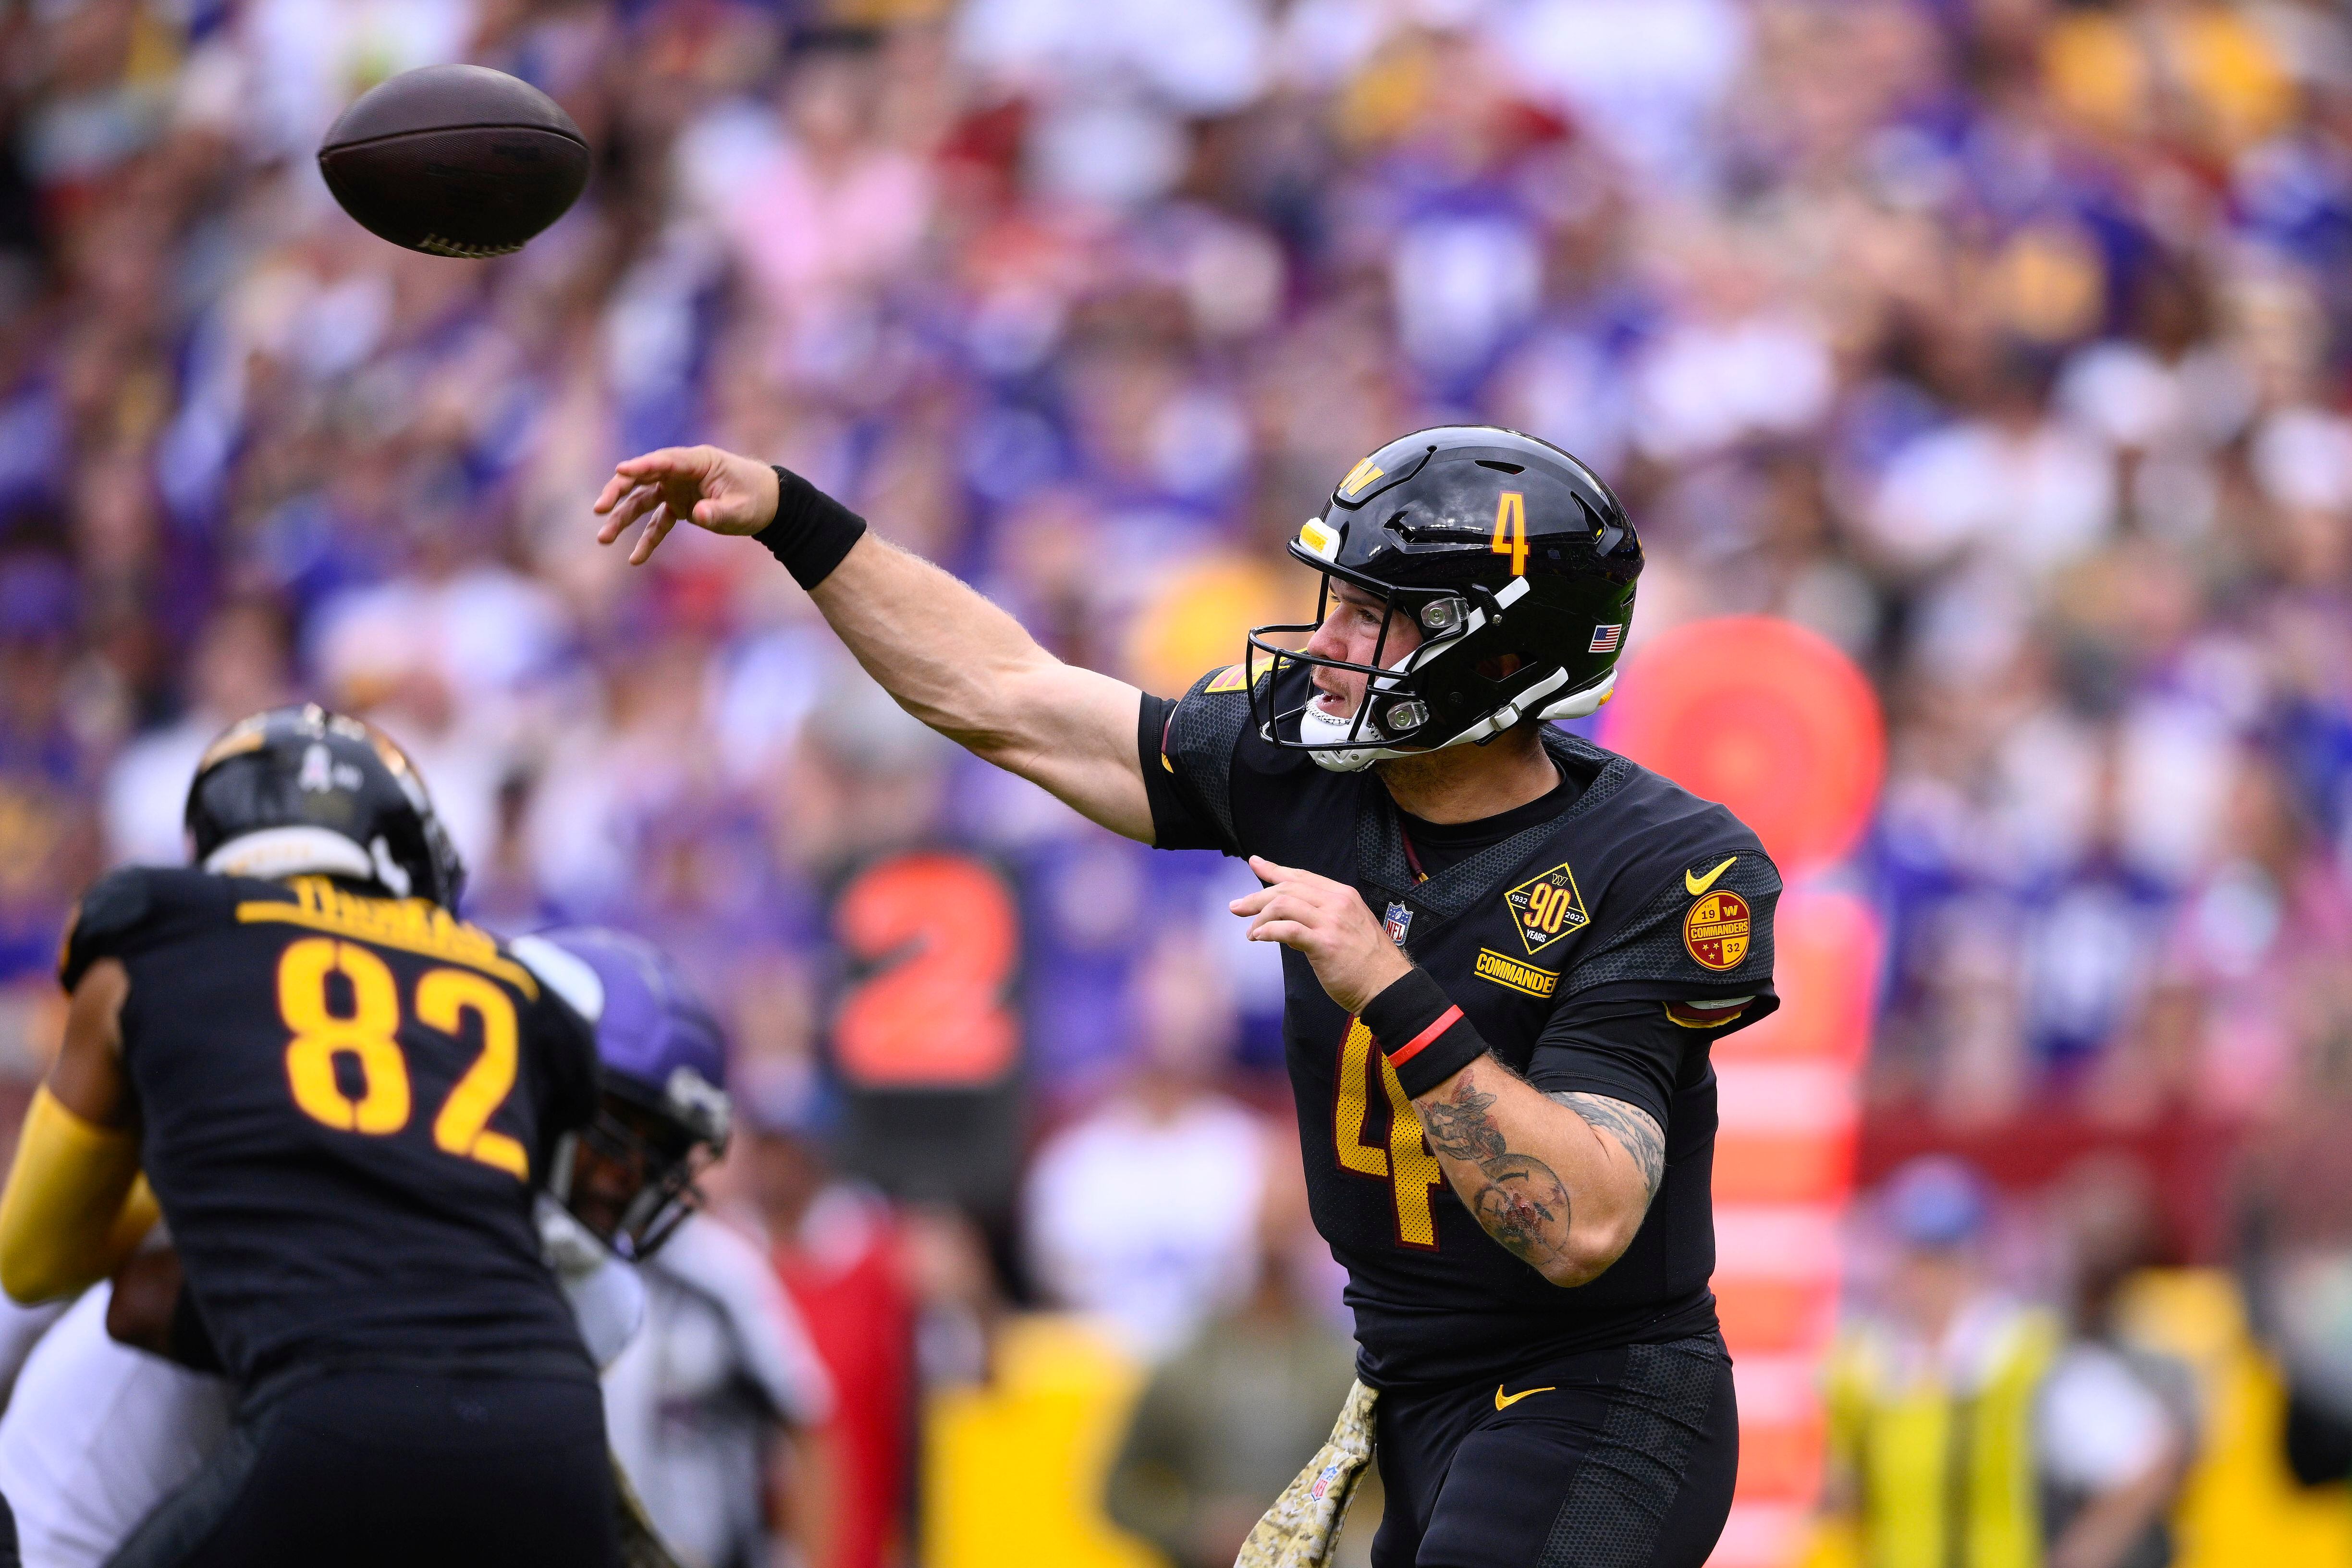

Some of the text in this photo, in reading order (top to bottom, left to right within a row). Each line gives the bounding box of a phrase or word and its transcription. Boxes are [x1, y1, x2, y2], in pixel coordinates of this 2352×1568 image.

[1489, 490, 1531, 577] 4
[1511, 894, 1528, 905] 1932
[1522, 882, 1572, 934] 90
[1565, 911, 1584, 923] 2022
[1701, 909, 1715, 919] 19
[1385, 919, 1402, 940] NFL
[1526, 929, 1546, 943] YEARS
[1690, 921, 1748, 939] COMMANDERS
[1727, 943, 1740, 953] 32
[832, 851, 1021, 1088] 2
[275, 935, 530, 1184] 82
[1331, 1013, 1447, 1253] 4
